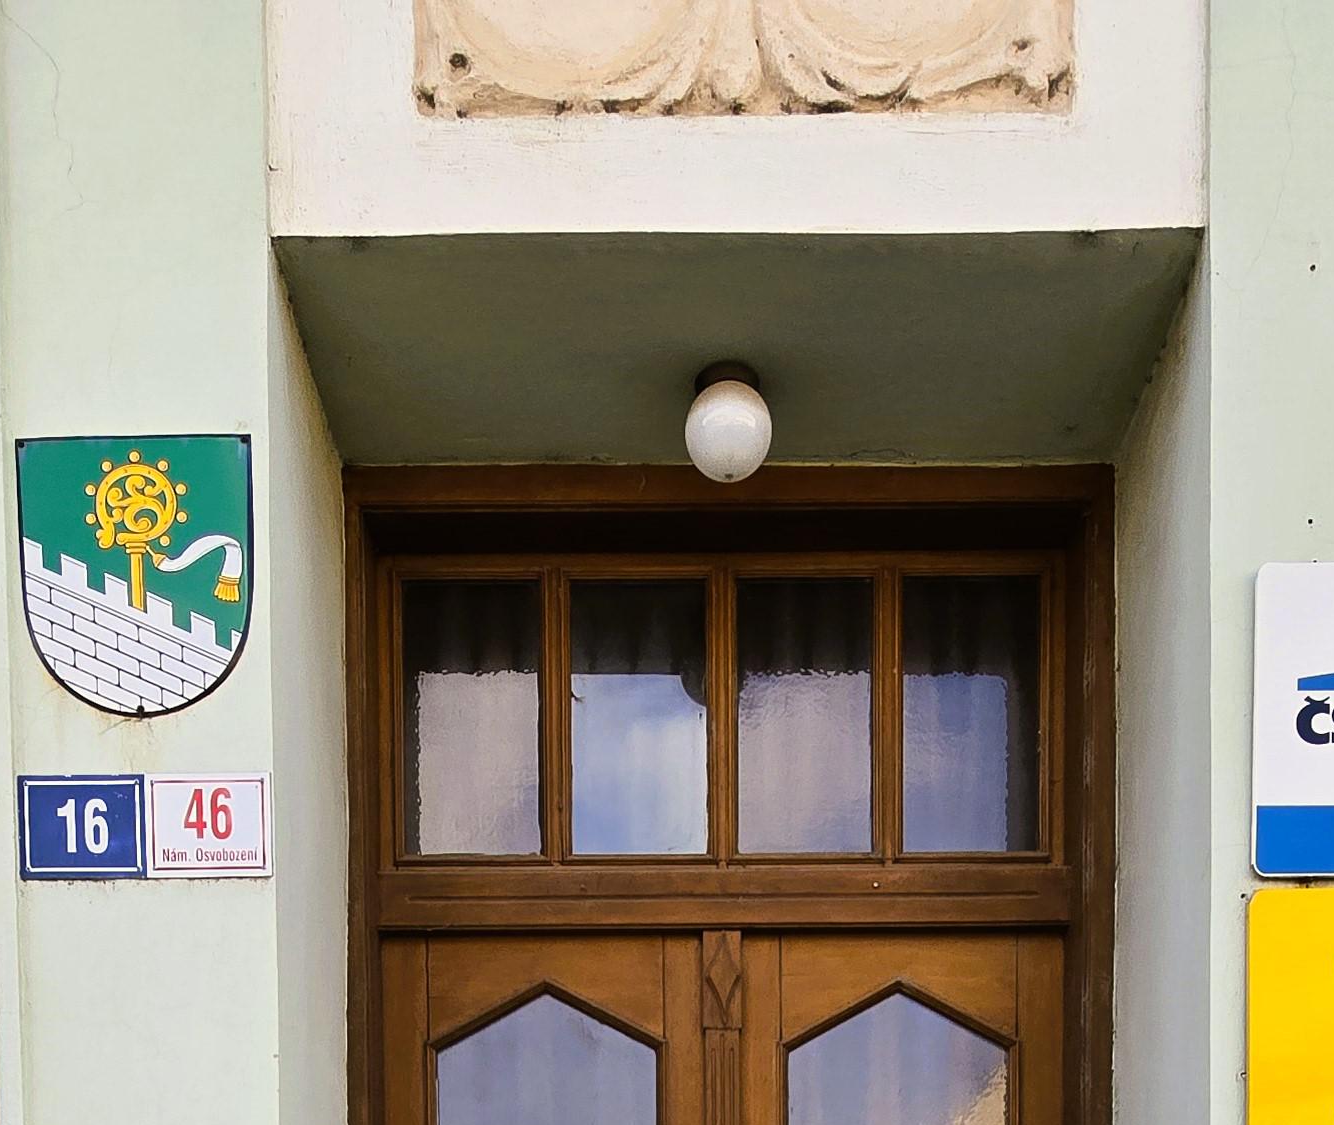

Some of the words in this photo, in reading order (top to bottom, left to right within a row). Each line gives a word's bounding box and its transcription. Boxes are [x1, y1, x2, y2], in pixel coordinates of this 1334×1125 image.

[57, 798, 109, 854] 16
[184, 787, 233, 840] 46
[162, 848, 191, 862] Nám.
[196, 846, 258, 862] Osvobození
